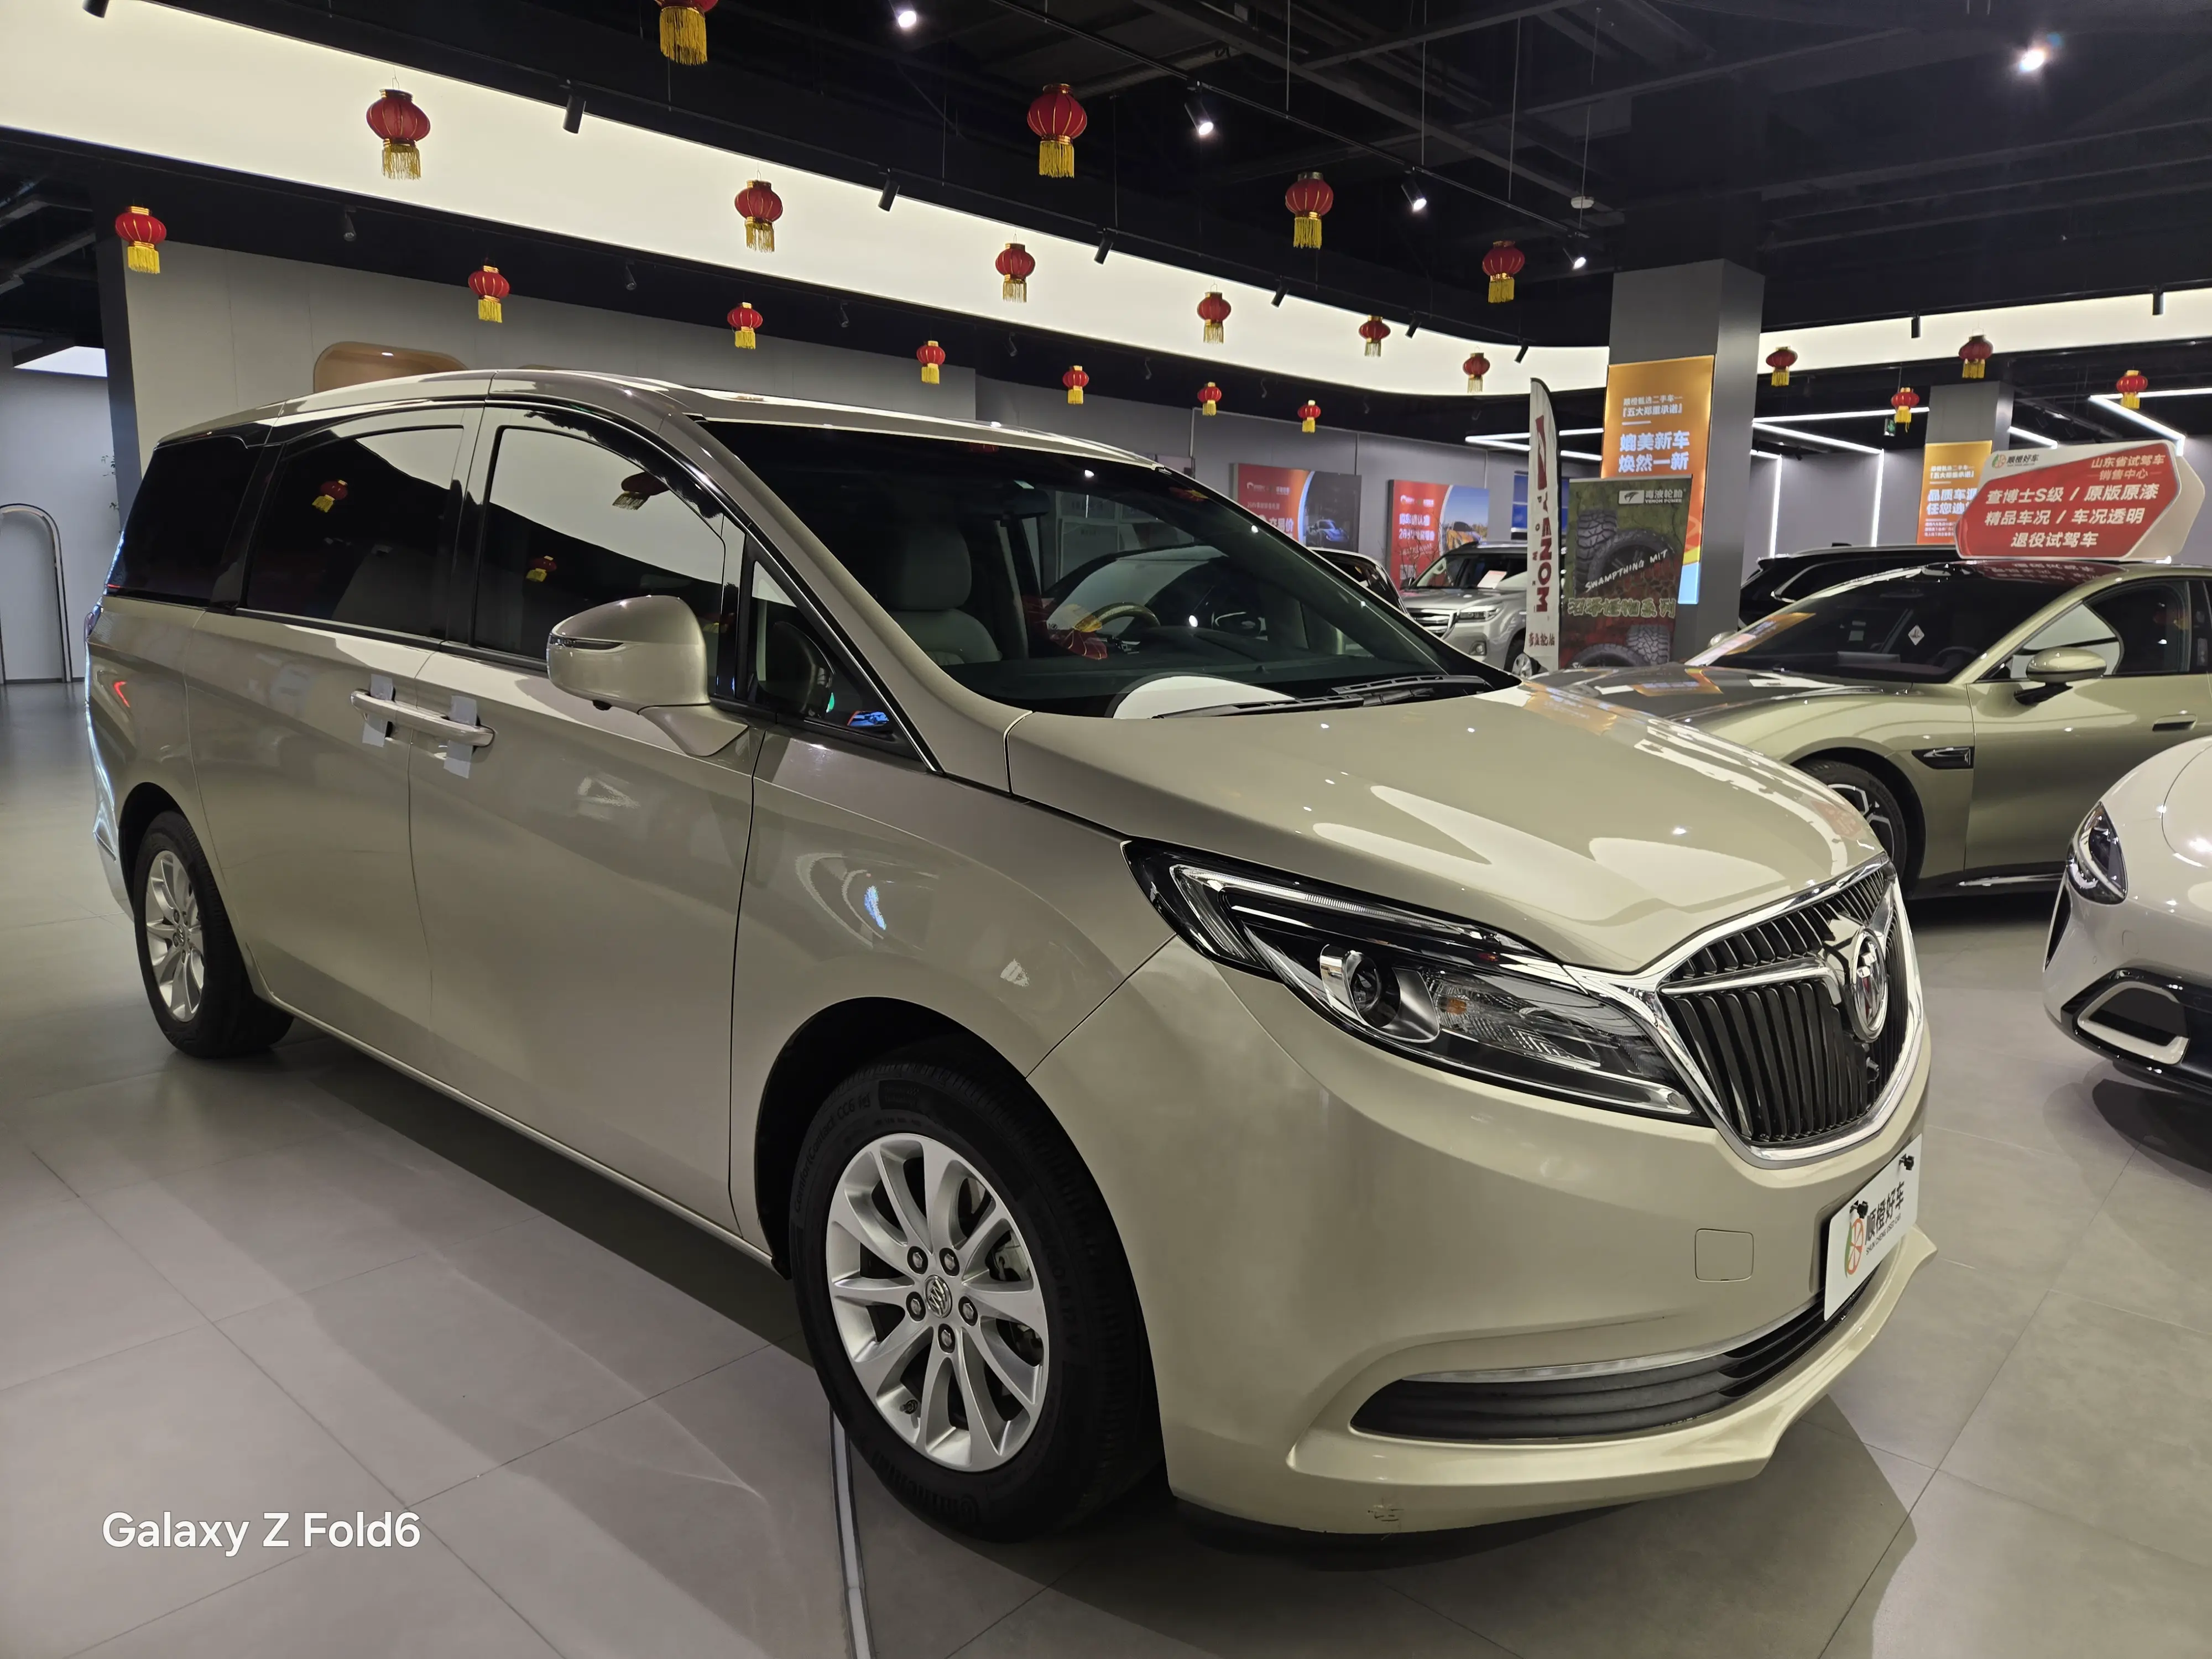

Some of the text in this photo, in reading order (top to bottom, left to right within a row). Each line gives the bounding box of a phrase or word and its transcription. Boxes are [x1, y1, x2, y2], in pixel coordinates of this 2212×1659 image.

[1620, 430, 1690, 452] 媲美新车
[1618, 451, 1689, 473] 焕然一新
[2091, 454, 2166, 468] 山东省试驾车
[2099, 468, 2148, 481] 销售中心
[1986, 487, 2064, 504] 查博士S级
[2084, 483, 2159, 502] 原版原漆
[1927, 502, 1970, 515] 任您选
[1984, 509, 2051, 526] 精品车况
[2072, 507, 2145, 525] 车况透明
[2011, 531, 2099, 547] 退役试驾车
[1536, 491, 1552, 613] VENOM
[1585, 559, 1644, 593] SWAMPTHING
[1865, 1181, 1905, 1246] 顺橙好车
